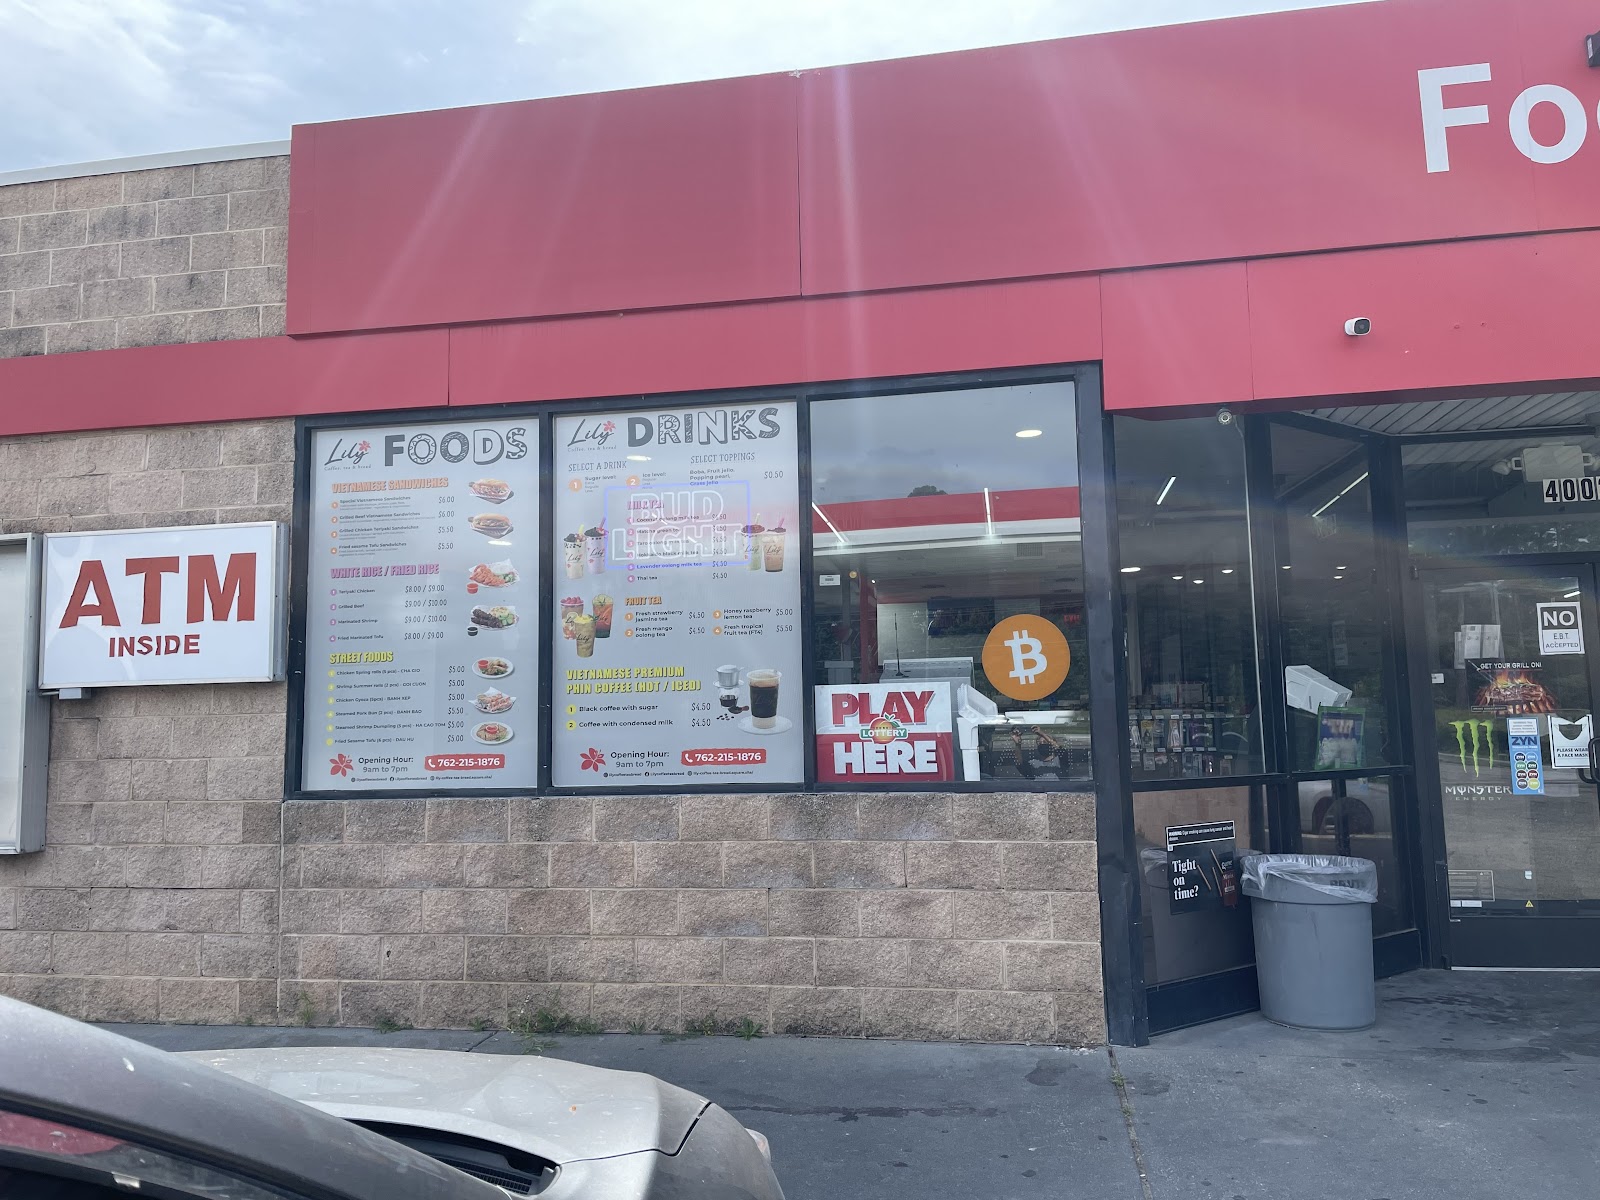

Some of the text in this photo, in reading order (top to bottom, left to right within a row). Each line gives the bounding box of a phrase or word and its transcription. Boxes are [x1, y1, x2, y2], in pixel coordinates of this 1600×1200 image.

[1417, 62, 1600, 173] Fo
[627, 407, 781, 447] DRINKS
[567, 418, 614, 447] Lily
[324, 438, 369, 465] Lily
[384, 427, 528, 467] FOODS
[690, 452, 755, 464] SELECT TOPPINGS
[568, 461, 627, 472] SELECT A DRINK
[764, 470, 784, 479] $0.50
[332, 477, 449, 493] VIETNAMESE SANDWICHES
[1545, 478, 1600, 501] 400
[630, 490, 724, 525] BUD
[438, 510, 455, 518] $6.00
[612, 523, 743, 560] LIGHT
[437, 543, 454, 551] $5.50
[331, 564, 439, 579] WHITE RICE / FRIED RICE
[712, 572, 728, 580] $4.50
[58, 552, 257, 629] ATM
[405, 585, 421, 593] $8.00
[428, 584, 445, 592] $9.00
[405, 600, 421, 608] $9.00
[428, 599, 447, 607] $10.00
[625, 596, 662, 606] FRUIT TEA
[688, 611, 705, 619] $4.50
[776, 608, 793, 617] $5.00
[428, 615, 447, 623] $10.00
[1542, 610, 1575, 626] NO
[688, 627, 705, 635] $4.50
[776, 624, 793, 633] $5.50
[109, 634, 200, 657] INSIDE
[329, 651, 393, 664] STREET FOODS
[449, 665, 465, 673] $5.00
[566, 666, 684, 680] VIETNAMESE PREMIUM
[448, 679, 464, 687] $5.00
[566, 683, 592, 694] PHIN
[594, 682, 632, 694] COFFEE
[663, 681, 669, 691] /
[448, 693, 464, 701] $5.00
[448, 707, 464, 715] $5.50
[638, 704, 658, 712] sugar
[691, 702, 711, 711] $4.50
[832, 691, 935, 727] PLAY
[448, 721, 464, 729] $5.00
[619, 719, 657, 727] condensed
[691, 718, 711, 727] $4.50
[862, 729, 905, 737] LOTTERY
[447, 735, 464, 743] $5.00
[1512, 736, 1538, 746] ZYN
[610, 750, 670, 760] Opening Hour:
[695, 752, 761, 762] 762-215-1876
[834, 740, 938, 774] HERE
[358, 757, 390, 765] Opening
[437, 757, 500, 767] 762-215-1876
[645, 760, 664, 768] 7pm
[391, 765, 408, 773] 7pm
[1445, 785, 1513, 796] MONSTER
[1171, 859, 1196, 874] Tight
[1173, 876, 1185, 886] on
[1174, 885, 1199, 900] time?
